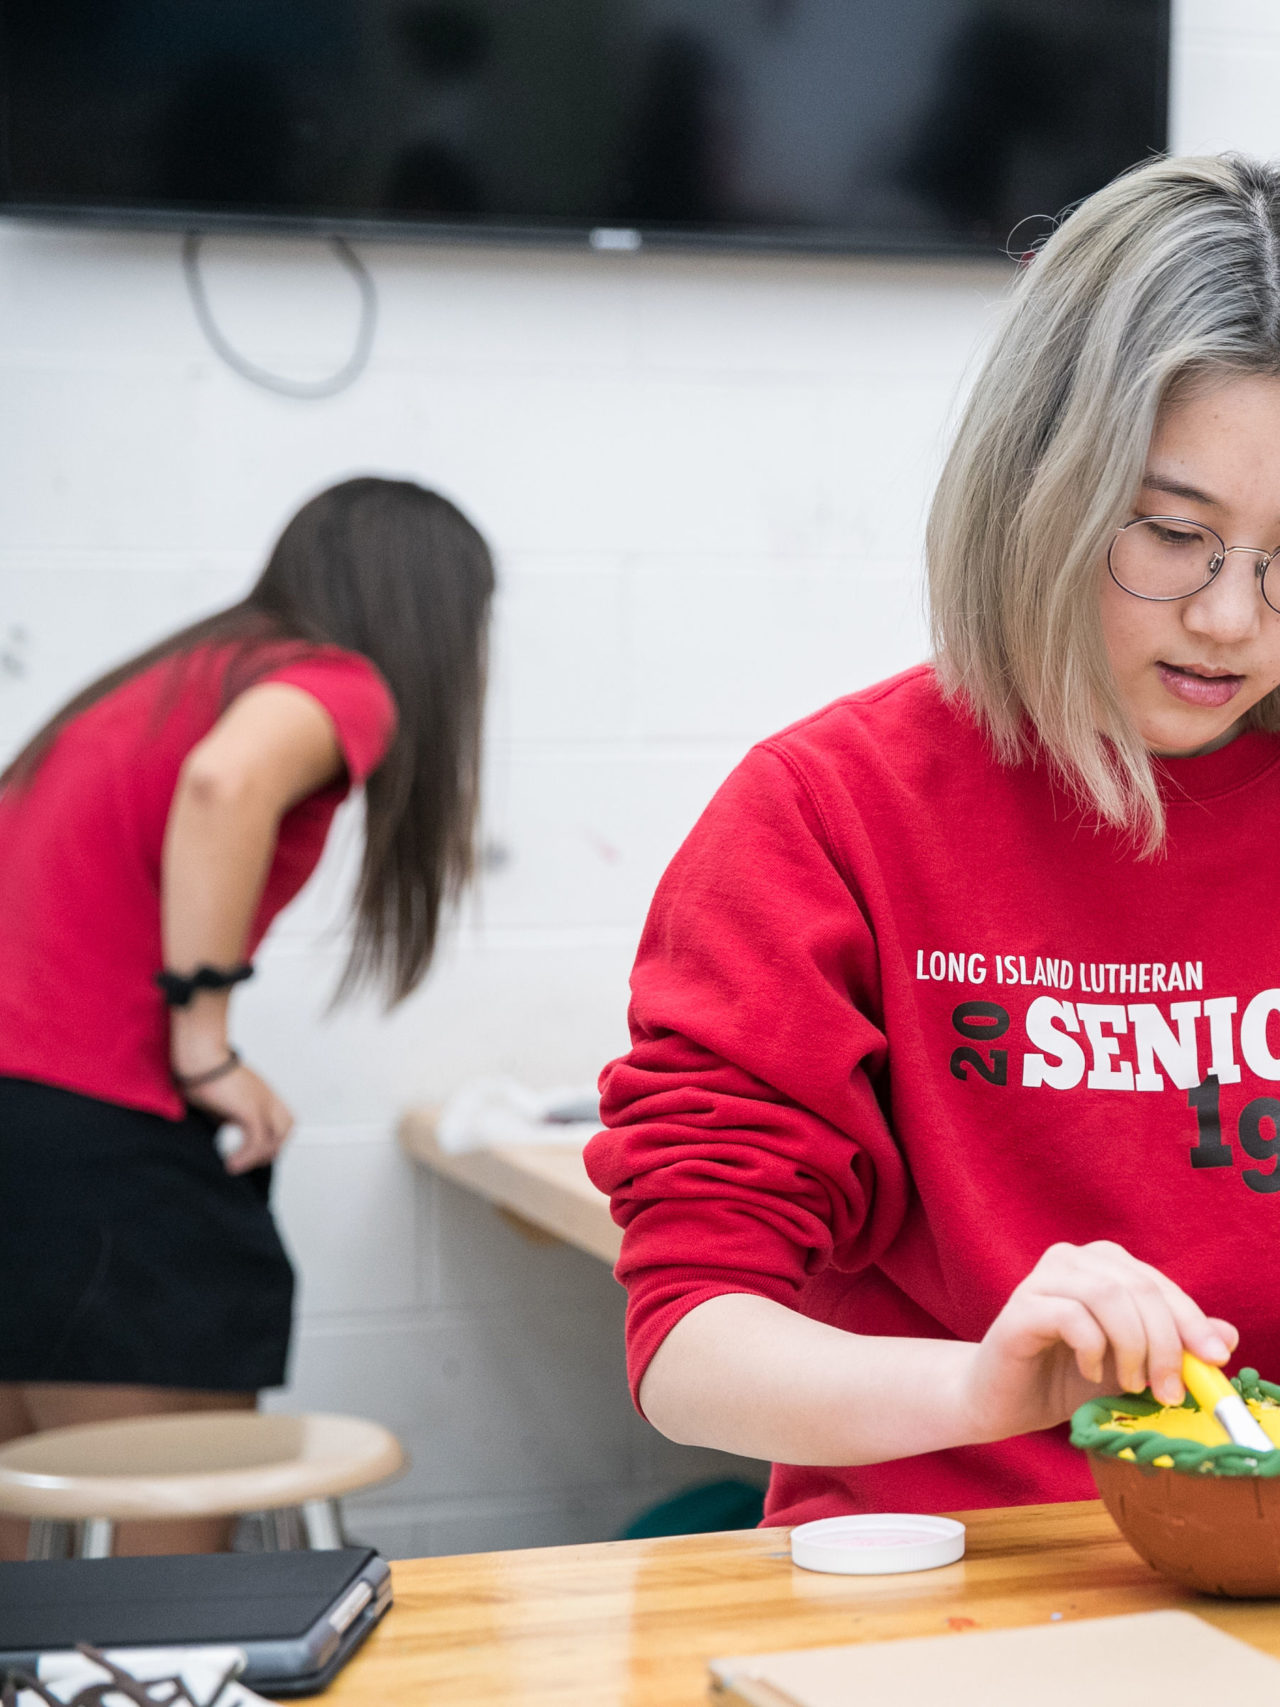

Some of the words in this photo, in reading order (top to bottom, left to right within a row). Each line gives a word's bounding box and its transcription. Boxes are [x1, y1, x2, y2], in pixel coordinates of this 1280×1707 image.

[916, 950, 986, 984] LONG
[996, 955, 1074, 989] ISLAND
[1080, 961, 1203, 992] LUTHERAN
[950, 1000, 1010, 1086] 20
